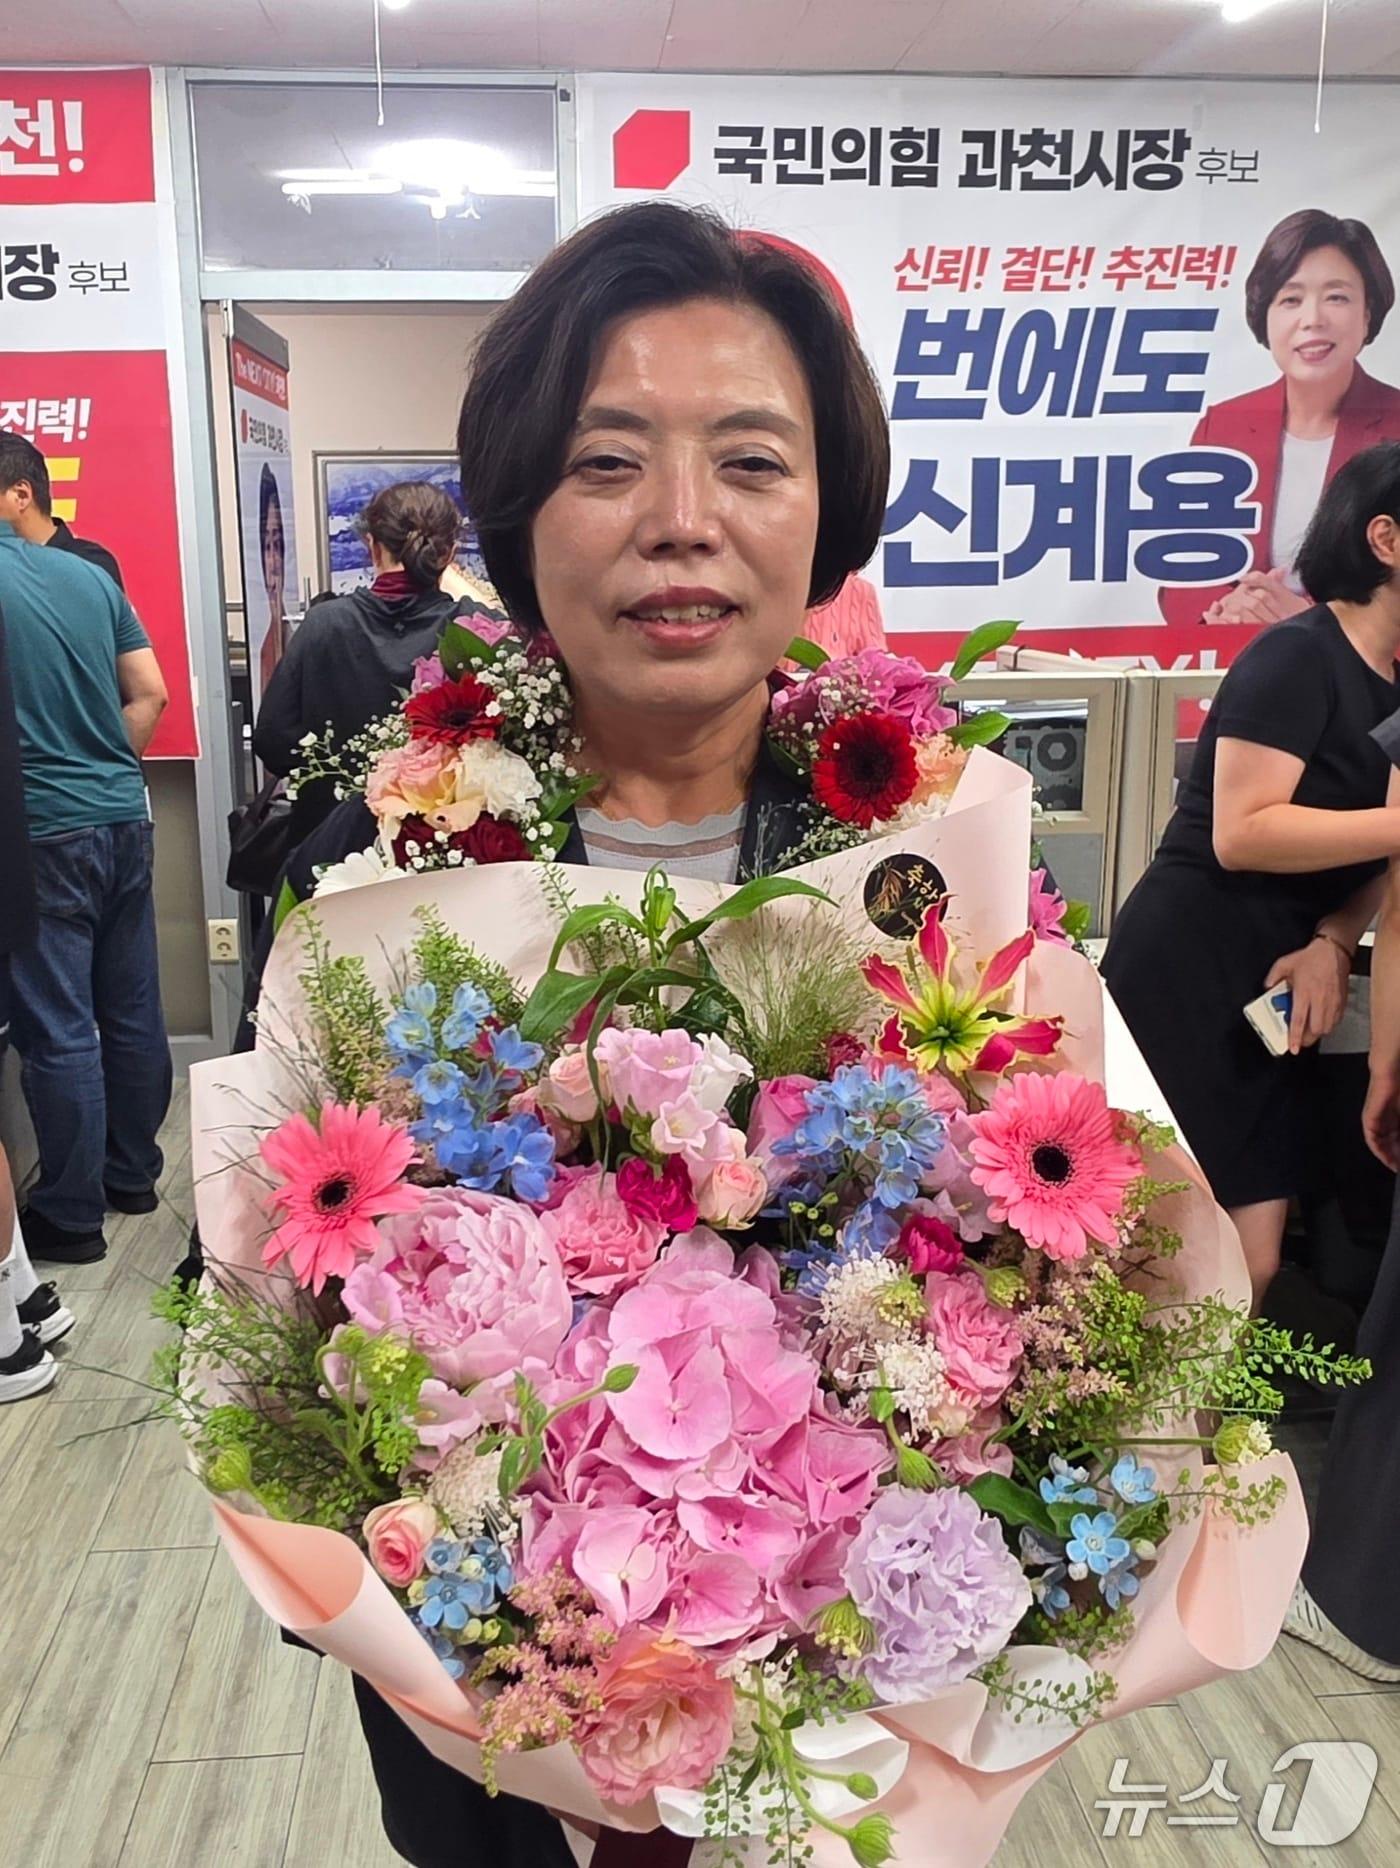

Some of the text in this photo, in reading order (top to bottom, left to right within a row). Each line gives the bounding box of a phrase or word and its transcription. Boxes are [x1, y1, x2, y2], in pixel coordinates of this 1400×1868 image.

[714, 126, 1259, 191] 국민의힘 과천시장 후보
[0, 244, 130, 300] 장 후보
[894, 245, 1237, 292] 신뢰! 결단! 추진력!
[890, 307, 1220, 420] 번에도
[879, 452, 1256, 588] 신계용
